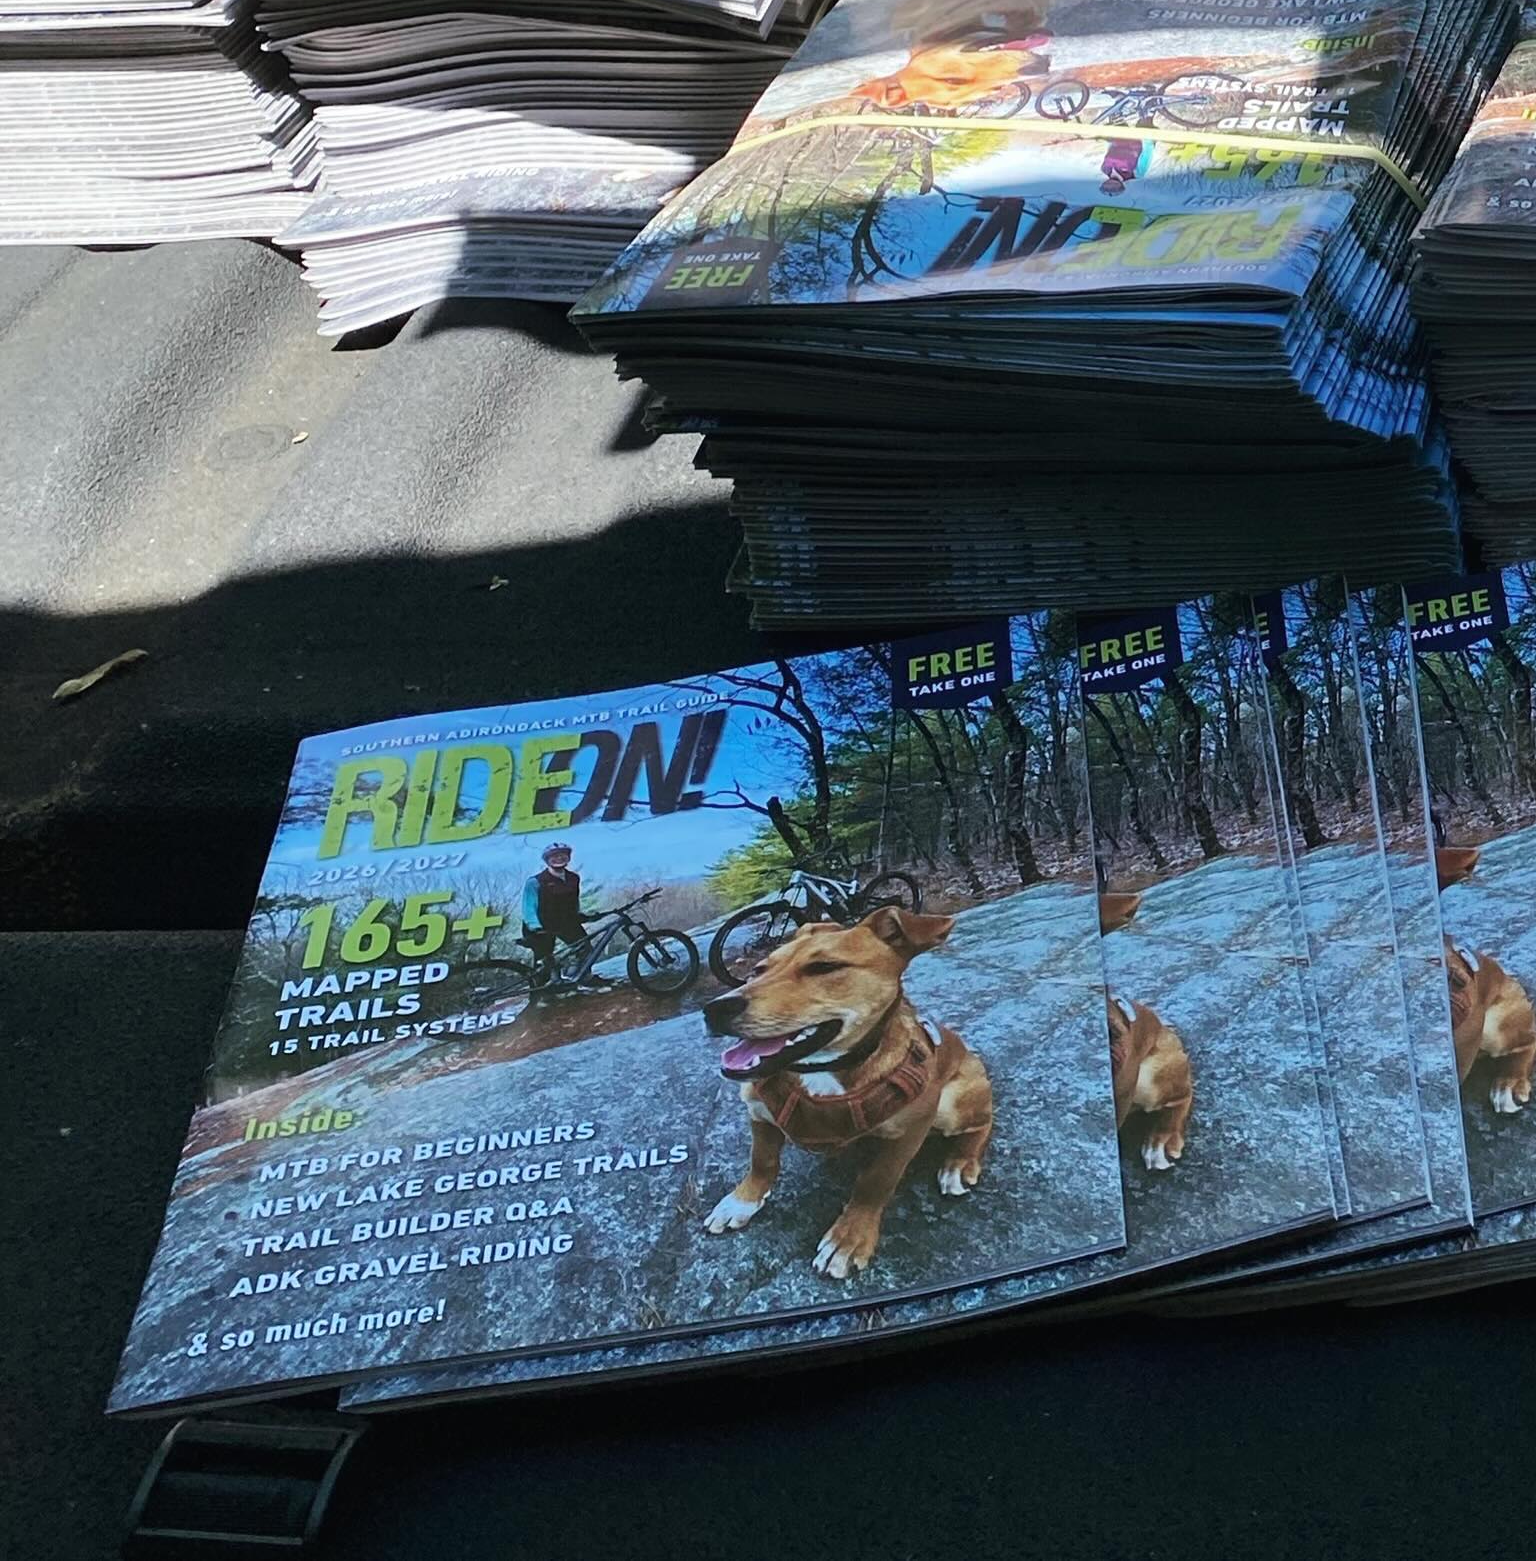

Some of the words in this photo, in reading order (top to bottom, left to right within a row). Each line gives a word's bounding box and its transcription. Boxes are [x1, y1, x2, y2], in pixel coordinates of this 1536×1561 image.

[1146, 8, 1269, 27] BEGINNERS
[1274, 15, 1317, 29] FOR
[1323, 8, 1369, 26] MTB
[1175, 75, 1270, 96] SYSTEMS
[1273, 83, 1328, 99] TRAIL
[1243, 97, 1350, 116] TRAILS
[1217, 115, 1345, 137] MAPPED
[1486, 196, 1502, 207] &
[1509, 199, 1533, 209] so
[683, 254, 716, 264] ONE
[719, 251, 761, 261] TAKE
[664, 264, 755, 290] FREE
[1409, 588, 1492, 625] FREE
[1411, 623, 1456, 641] TAKE
[1459, 615, 1493, 632] ONE
[908, 641, 996, 683] FREE
[1080, 625, 1166, 669] FREE
[909, 680, 956, 698] TAKE
[960, 671, 996, 688] ONE
[1082, 664, 1128, 683] TAKE
[1131, 653, 1167, 671] ONE
[341, 732, 440, 757] SOUTHERN
[446, 718, 566, 741] ADIRONDACK
[572, 710, 611, 726] MTB
[616, 703, 671, 720] TRAIL
[675, 691, 731, 709] GUIDE
[316, 708, 729, 860] RIDEON!
[307, 851, 468, 887] 2026/2027
[301, 891, 503, 970] 165+
[280, 962, 451, 1002] MAPPED
[274, 993, 421, 1031] TRAILS
[269, 1039, 298, 1056] 15
[308, 1028, 386, 1051] TRAIL
[394, 1010, 517, 1040] SYSTEMS
[244, 1109, 363, 1141] Inside:
[259, 1157, 329, 1182] MTB
[339, 1147, 404, 1172] FOR
[412, 1121, 596, 1162] BEGINNERS
[250, 1191, 328, 1220] NEW
[335, 1178, 425, 1208] LAKE
[433, 1160, 563, 1195] GEORGE
[573, 1144, 690, 1177] TRAILS
[241, 1227, 340, 1257] TRAIL
[350, 1206, 494, 1243] BUILDER
[504, 1196, 574, 1222] Q&A
[228, 1268, 305, 1298] ADK
[314, 1251, 449, 1286] GRAVEL
[459, 1233, 574, 1267] RIDING
[187, 1331, 209, 1357] &
[219, 1329, 256, 1351] so
[264, 1311, 348, 1344] much
[357, 1297, 447, 1332] more!
